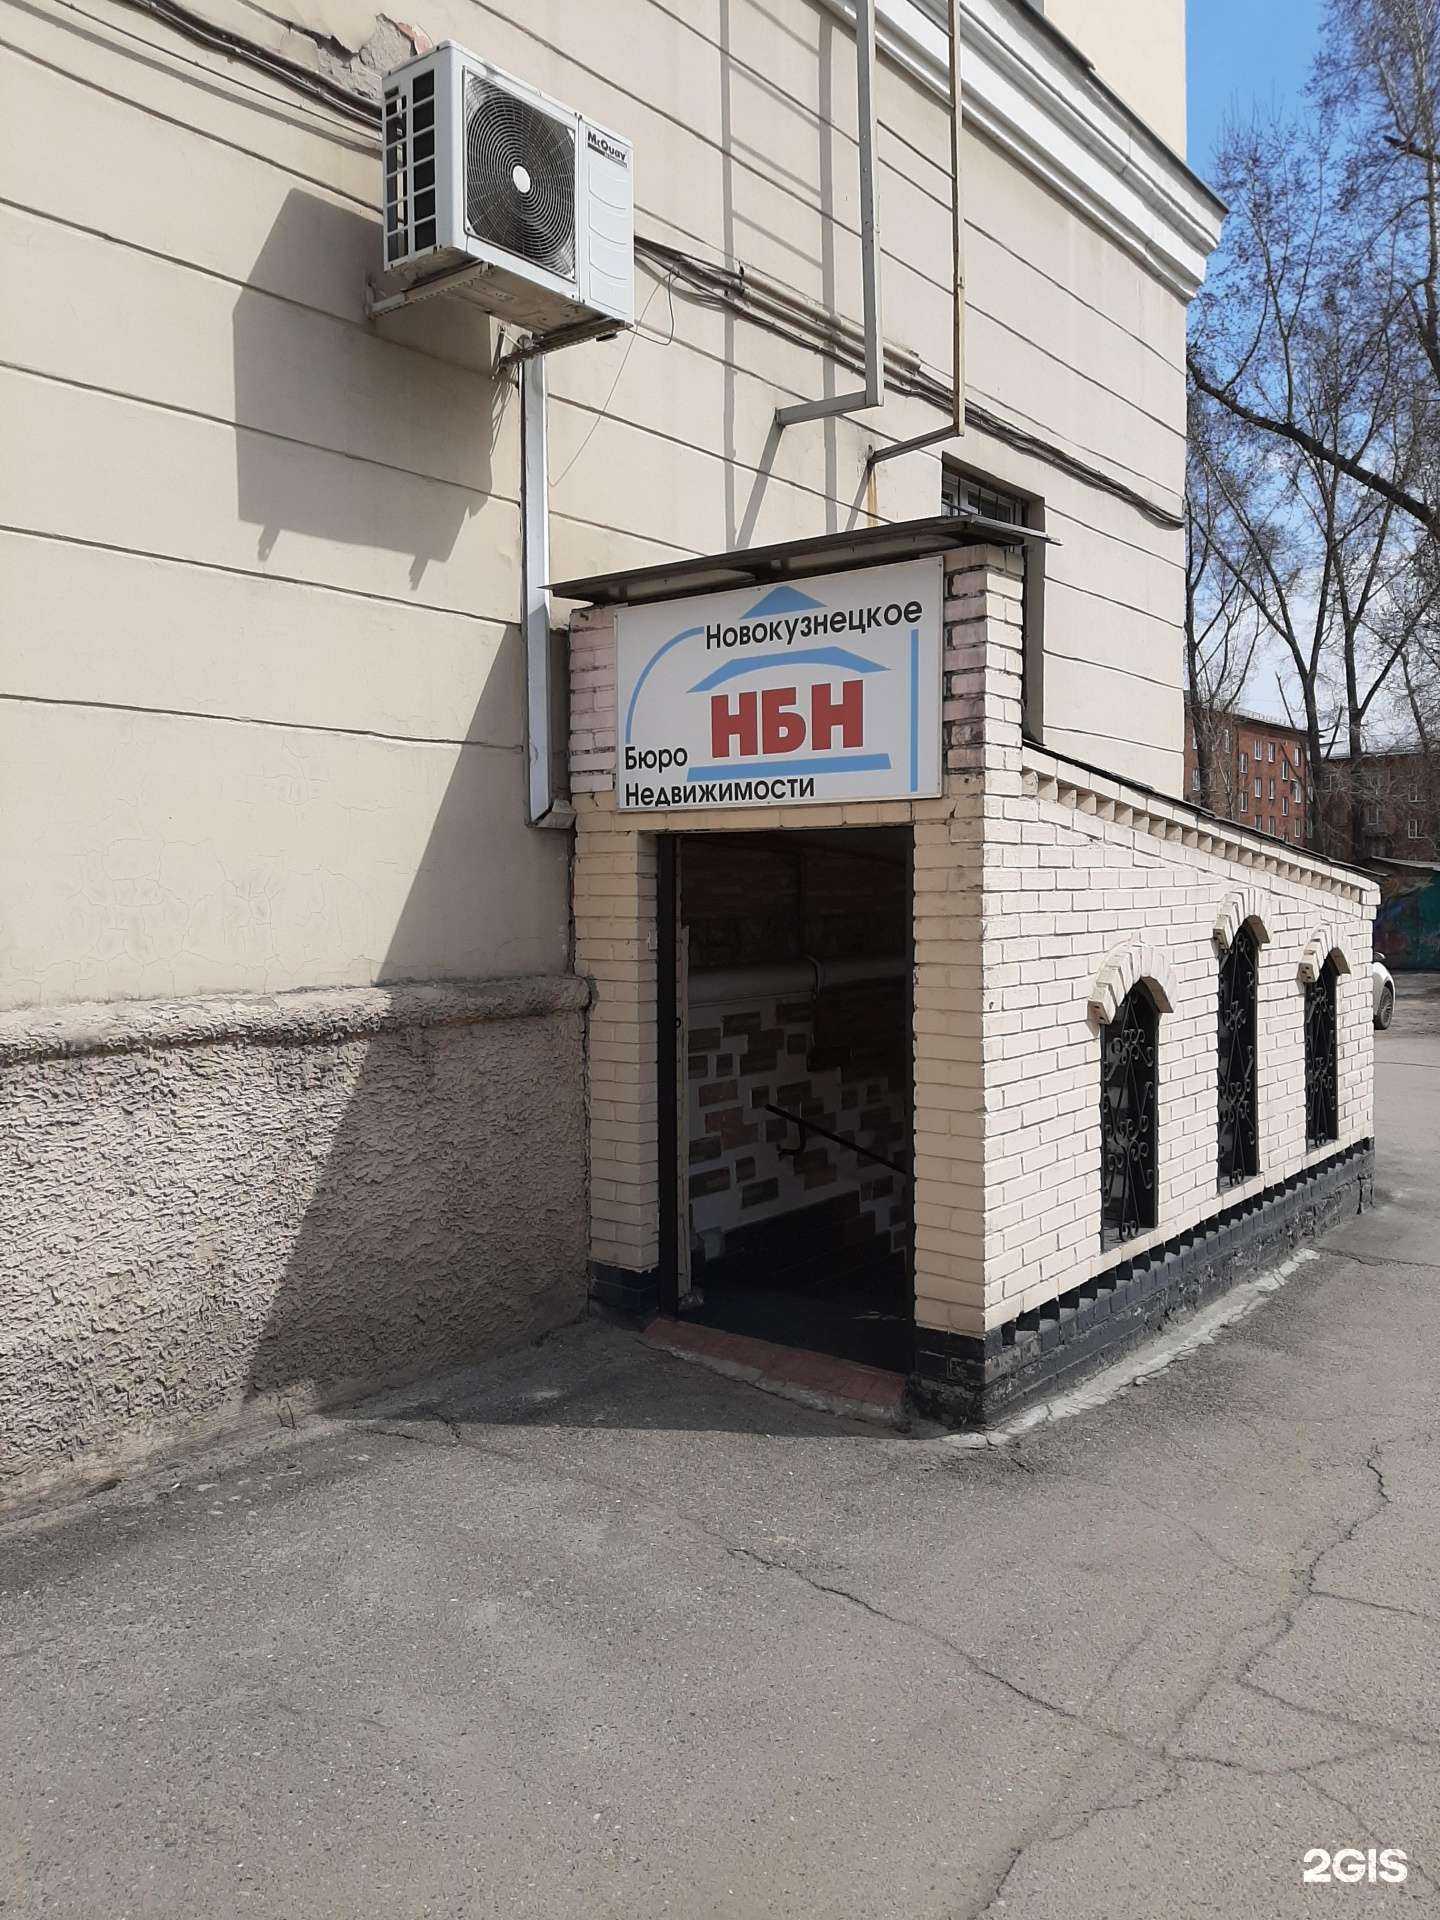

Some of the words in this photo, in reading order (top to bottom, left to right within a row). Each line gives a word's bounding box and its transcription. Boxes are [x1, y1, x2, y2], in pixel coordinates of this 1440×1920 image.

[587, 130, 626, 161] McQuay
[706, 600, 923, 649] Новокузнецкое
[711, 679, 864, 759] НБН
[625, 746, 688, 774] Бюро
[625, 777, 815, 807] Недвижимости
